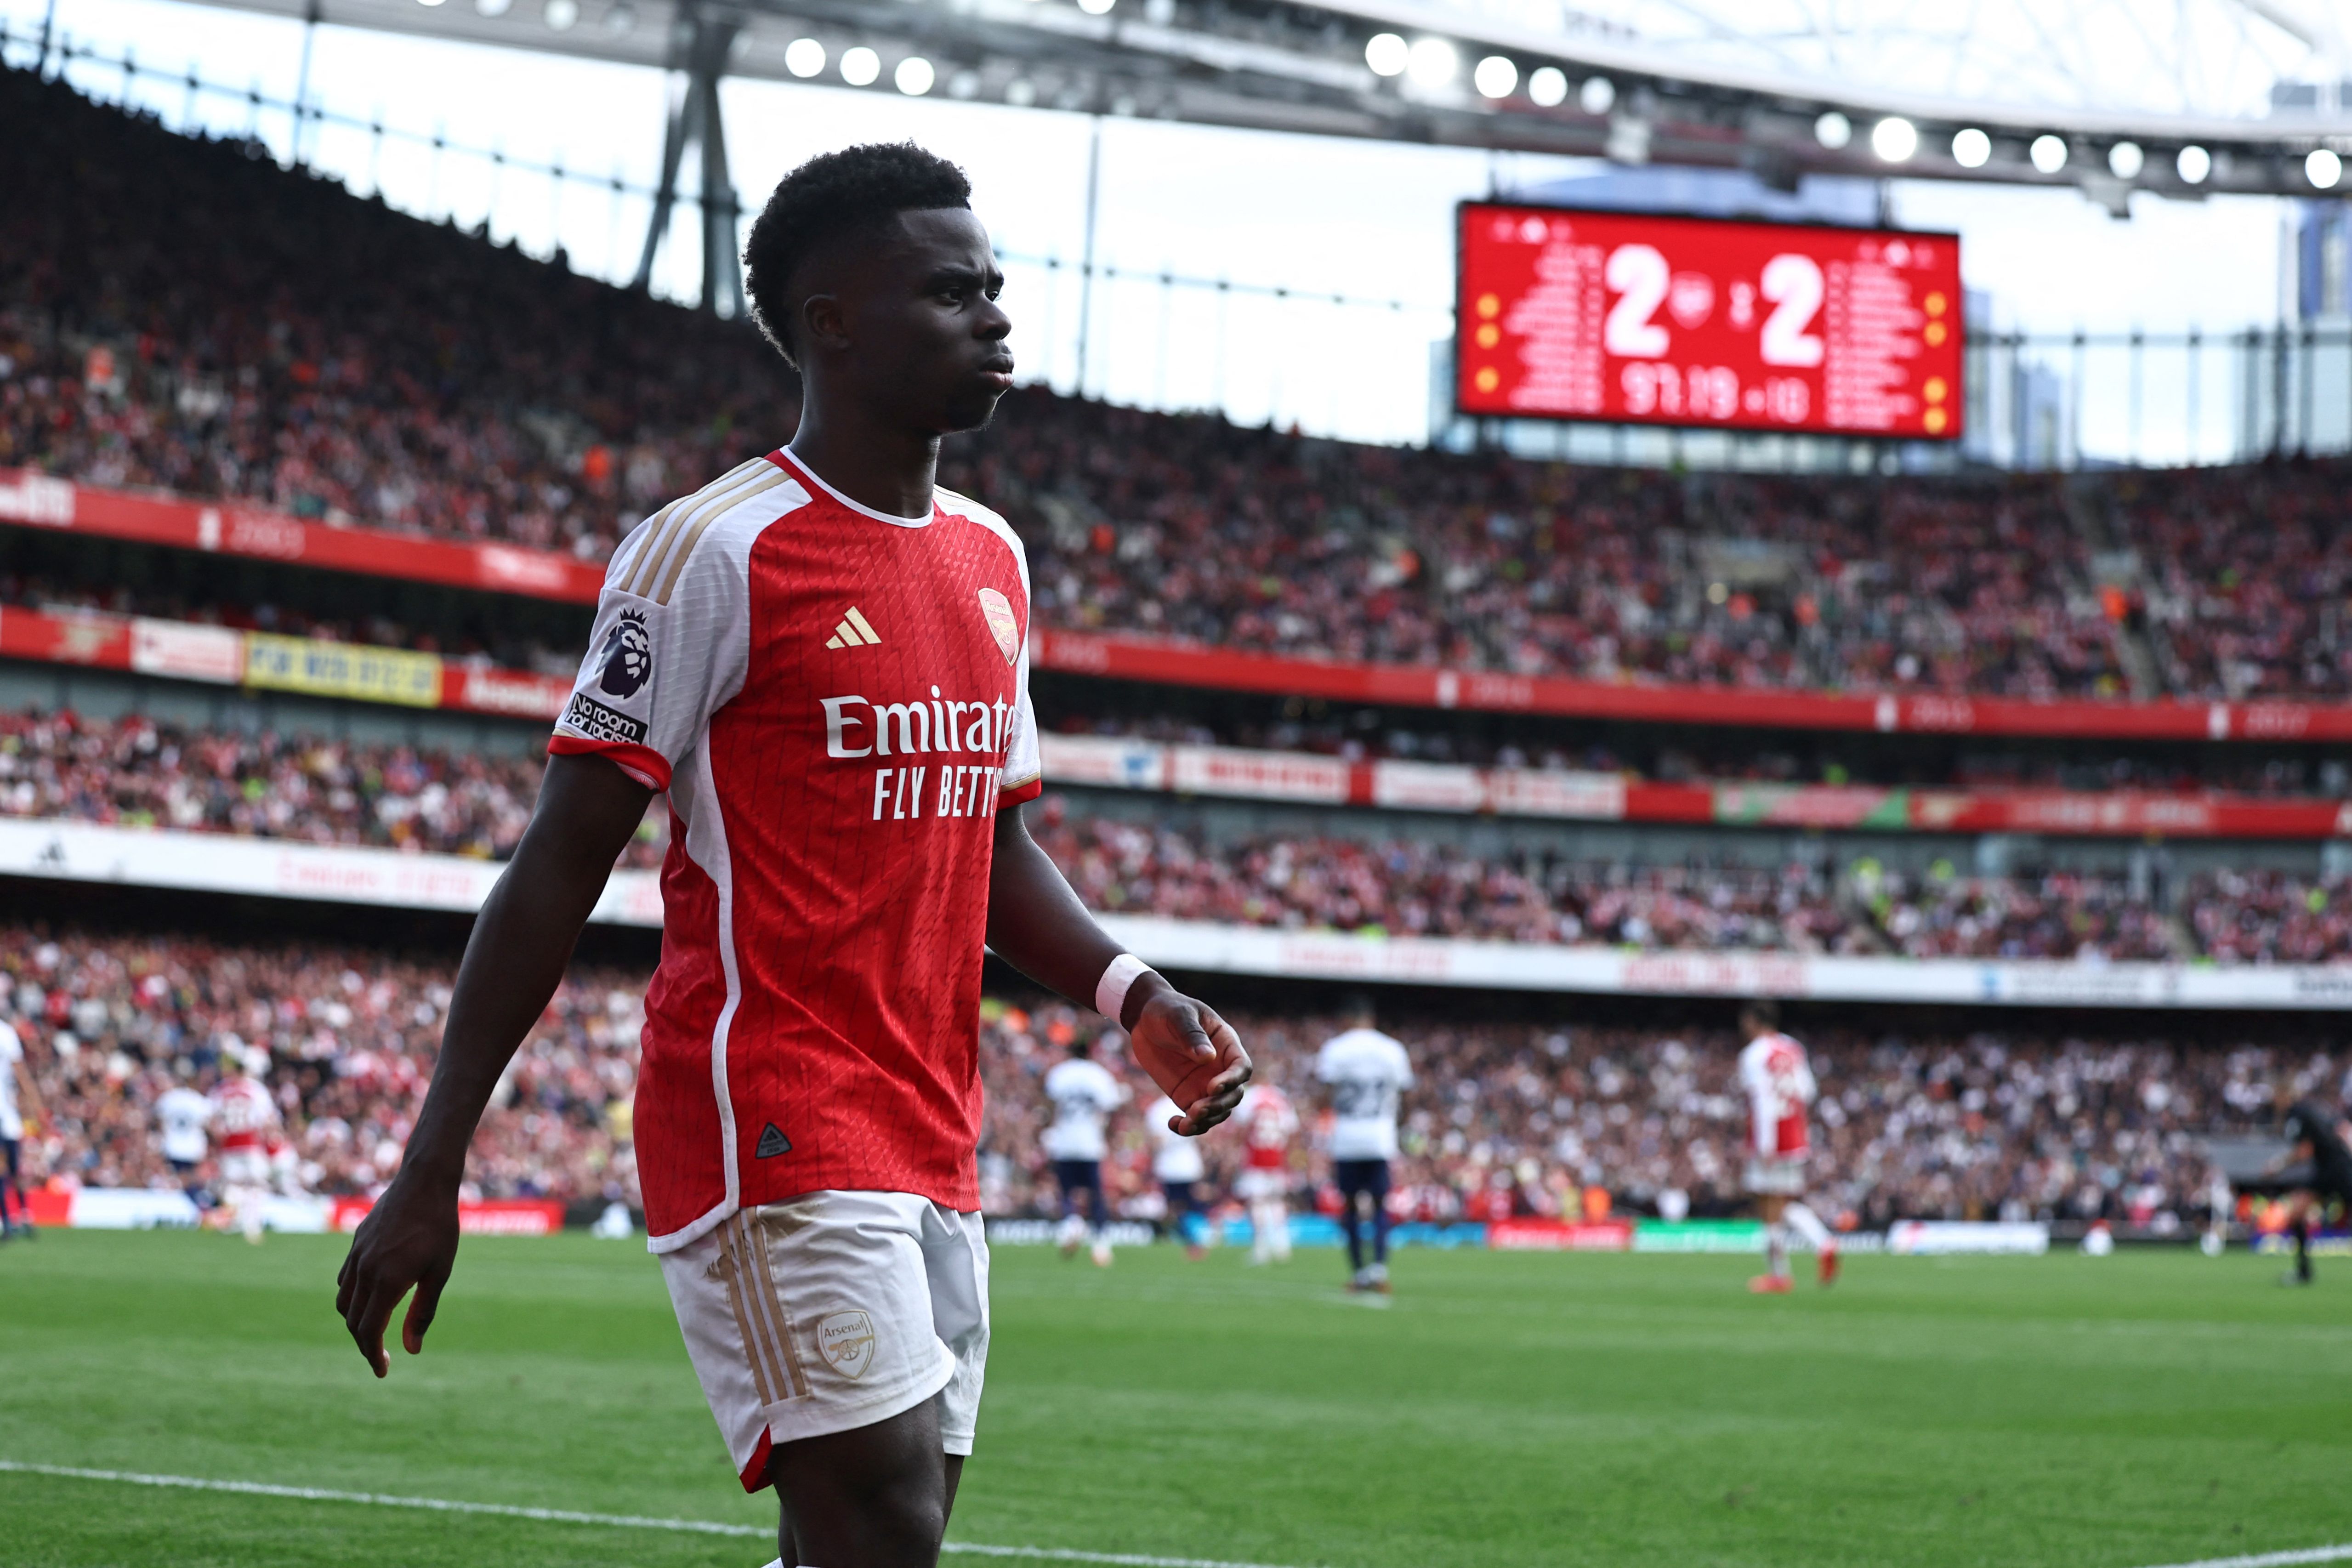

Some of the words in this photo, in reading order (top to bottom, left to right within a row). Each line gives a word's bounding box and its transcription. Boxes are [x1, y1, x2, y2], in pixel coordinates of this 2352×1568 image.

[1604, 244, 1670, 358] 2
[1761, 253, 1824, 367] 2
[986, 600, 1011, 616] Arsenal
[573, 693, 592, 716] No
[593, 706, 637, 737] room
[819, 685, 1015, 758] Emirate
[873, 767, 926, 820] FLY
[824, 1320, 864, 1339] Arsenal
